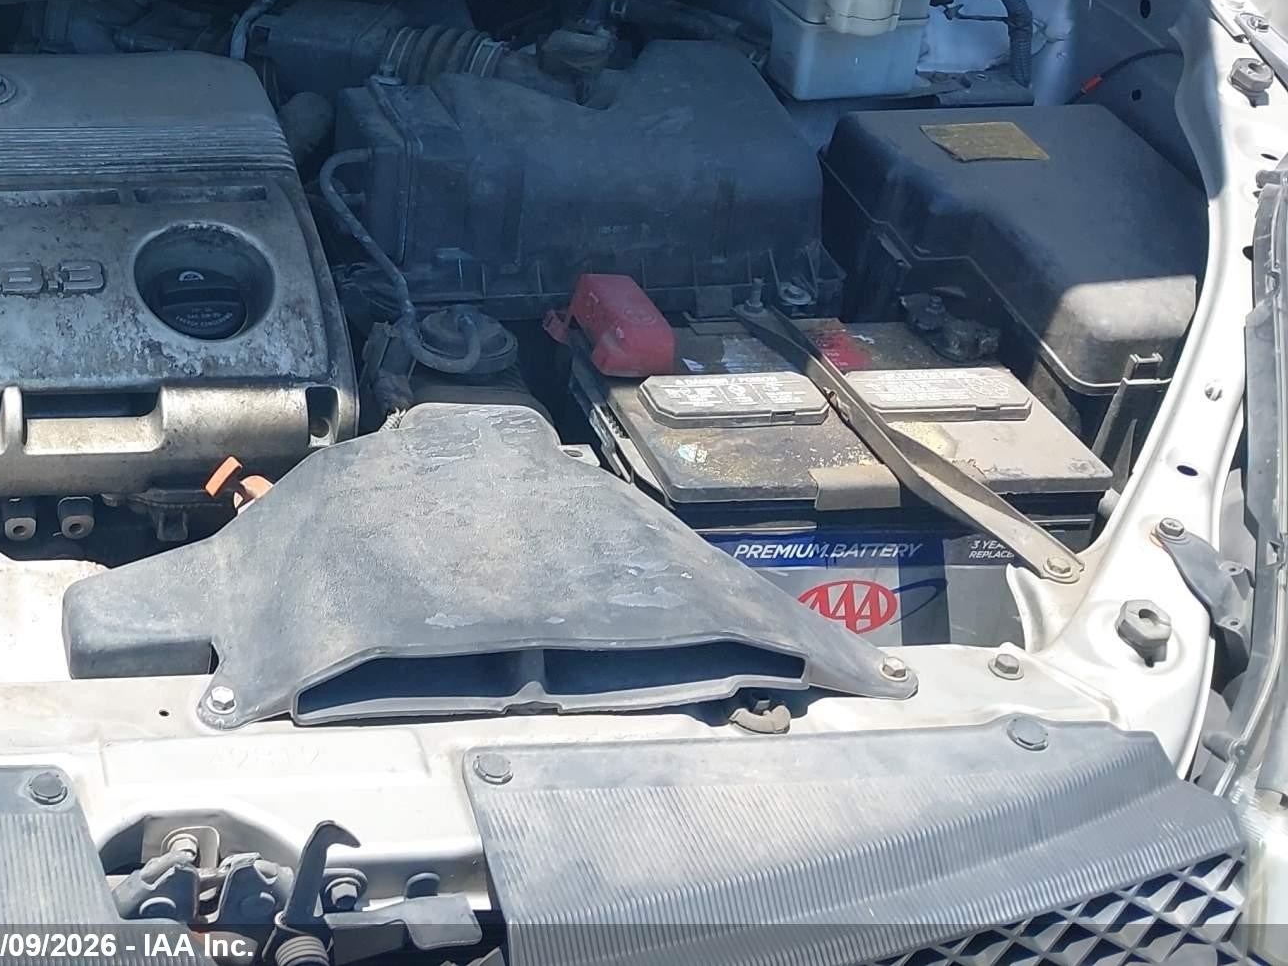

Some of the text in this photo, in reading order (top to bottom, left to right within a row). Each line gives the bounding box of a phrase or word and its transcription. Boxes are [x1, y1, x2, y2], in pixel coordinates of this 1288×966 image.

[0, 261, 105, 297] 3.3
[734, 542, 924, 559] PREMIUM BATTERY
[971, 540, 981, 549] 3
[801, 581, 890, 633] AAA
